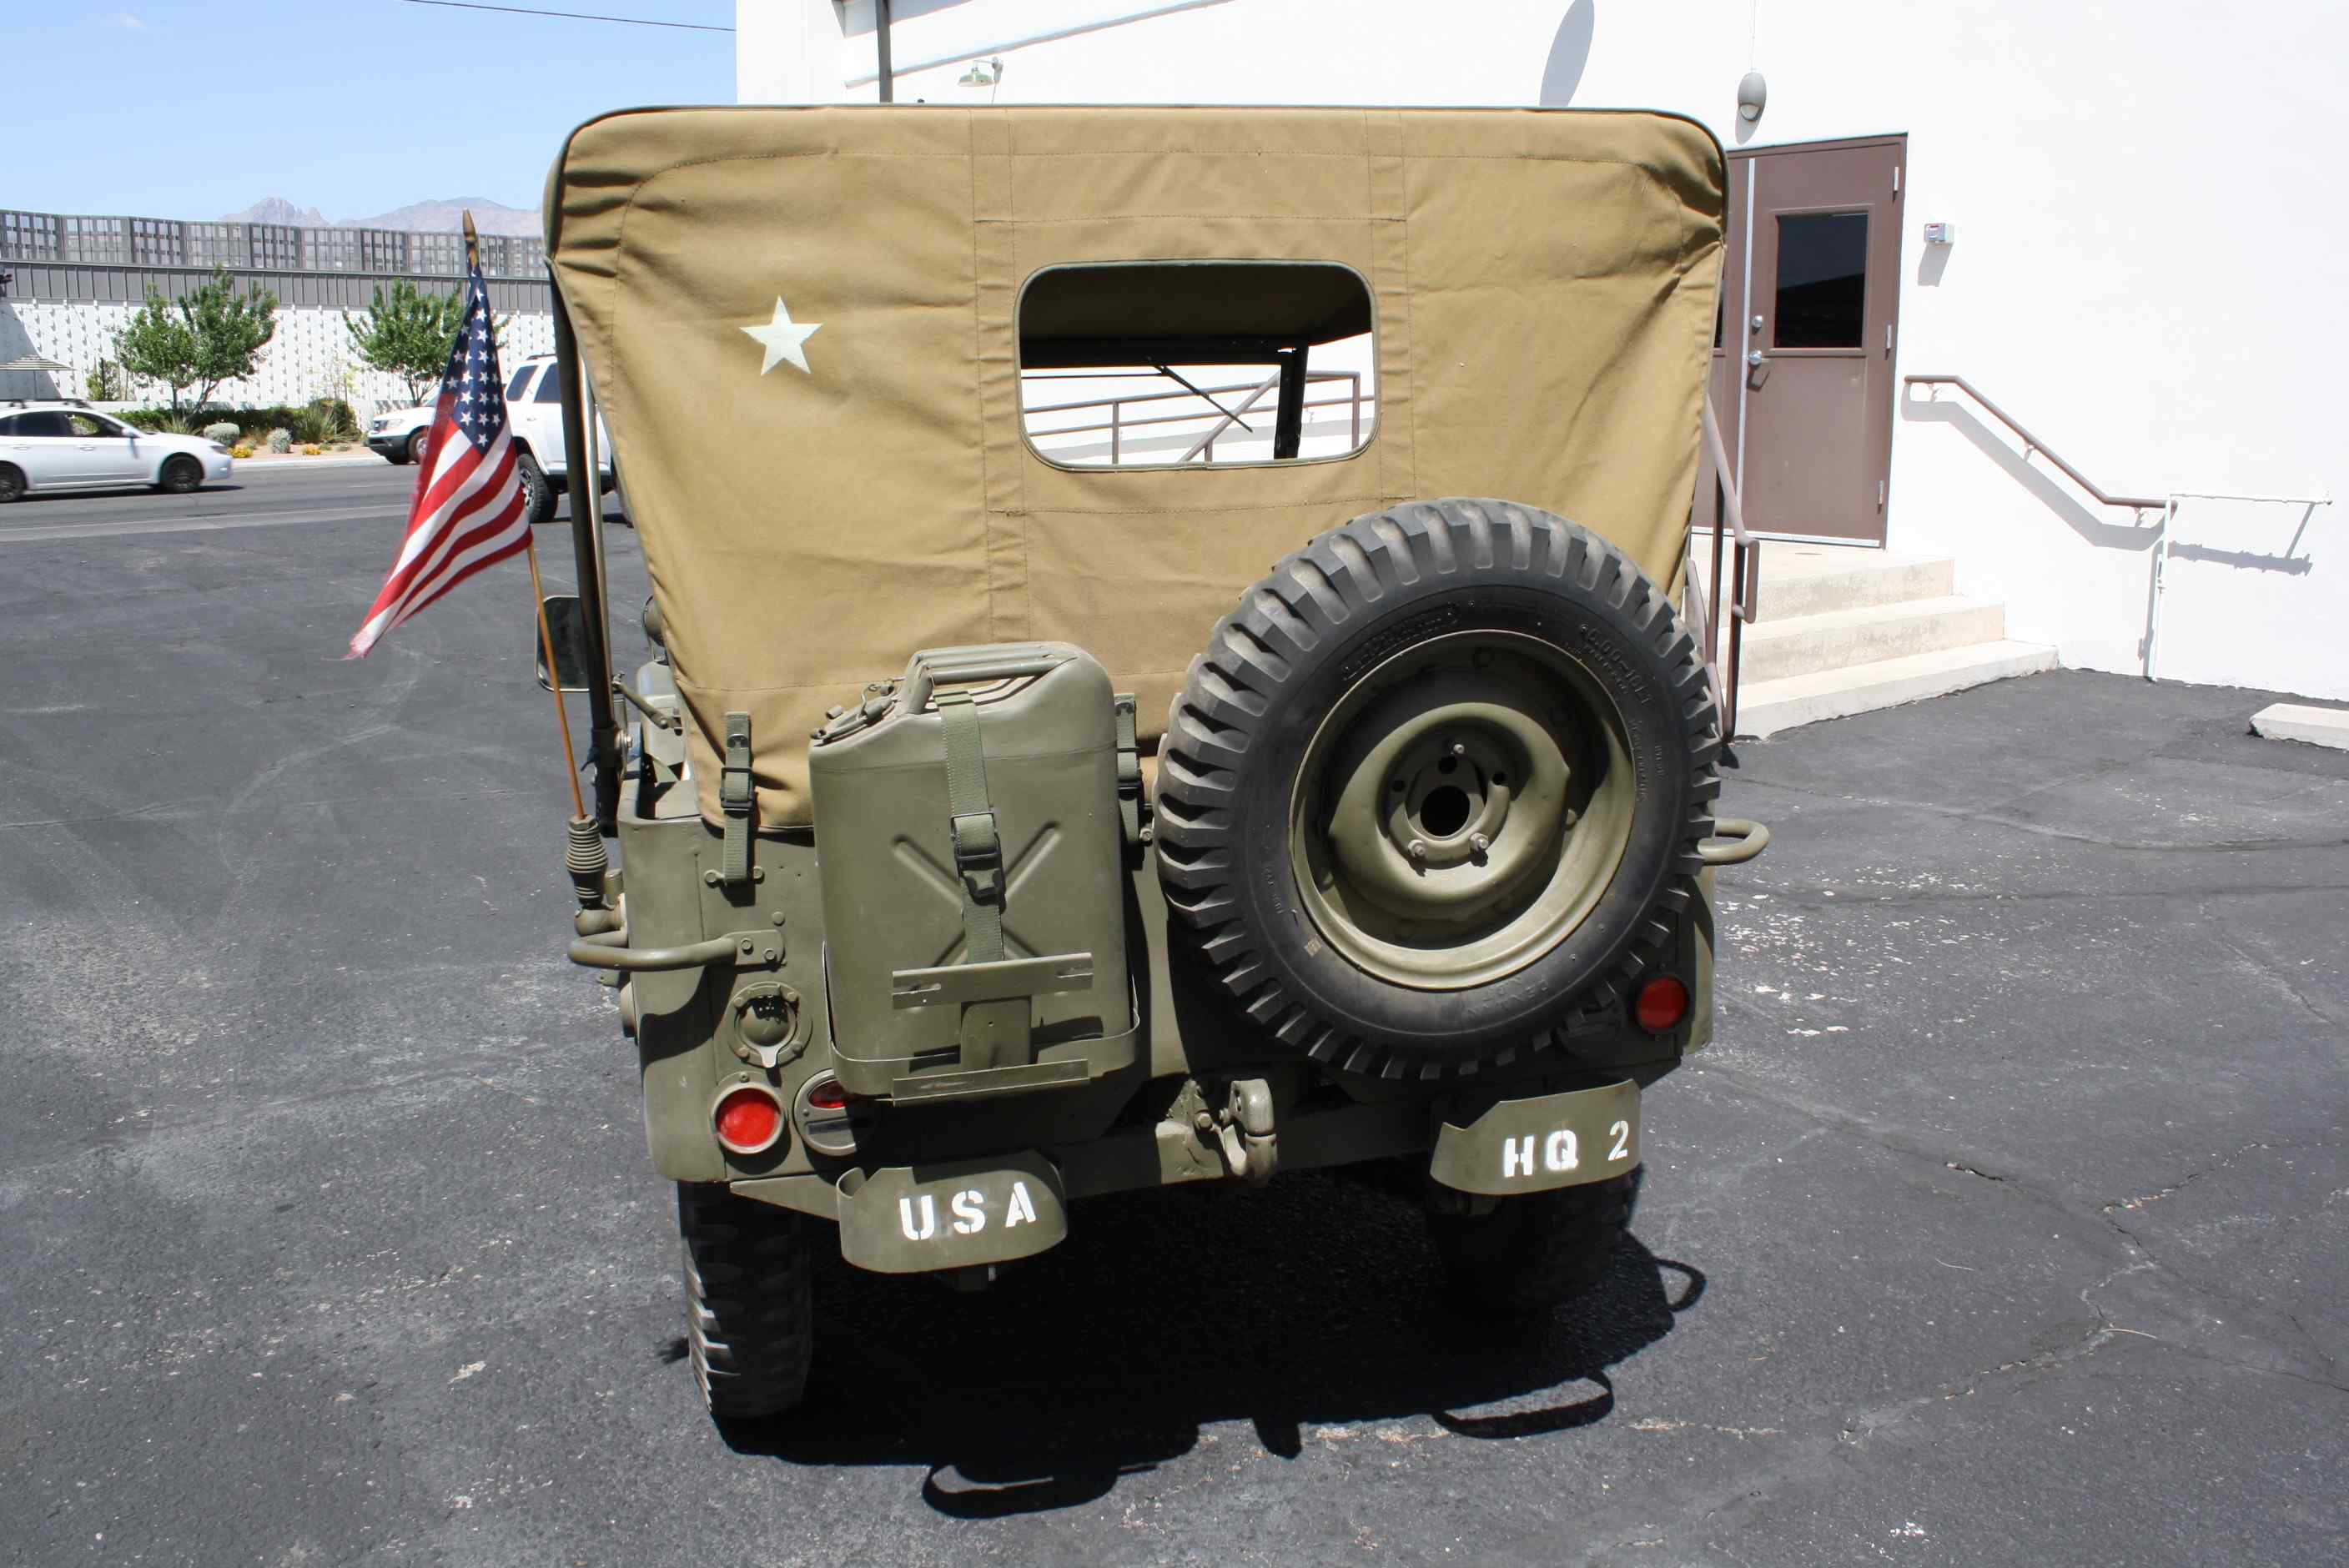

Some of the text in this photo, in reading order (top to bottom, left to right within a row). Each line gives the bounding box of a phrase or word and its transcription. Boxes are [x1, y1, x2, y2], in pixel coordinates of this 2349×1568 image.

[1504, 1120, 1629, 1178] HQ 2
[899, 1181, 1037, 1240] USA
